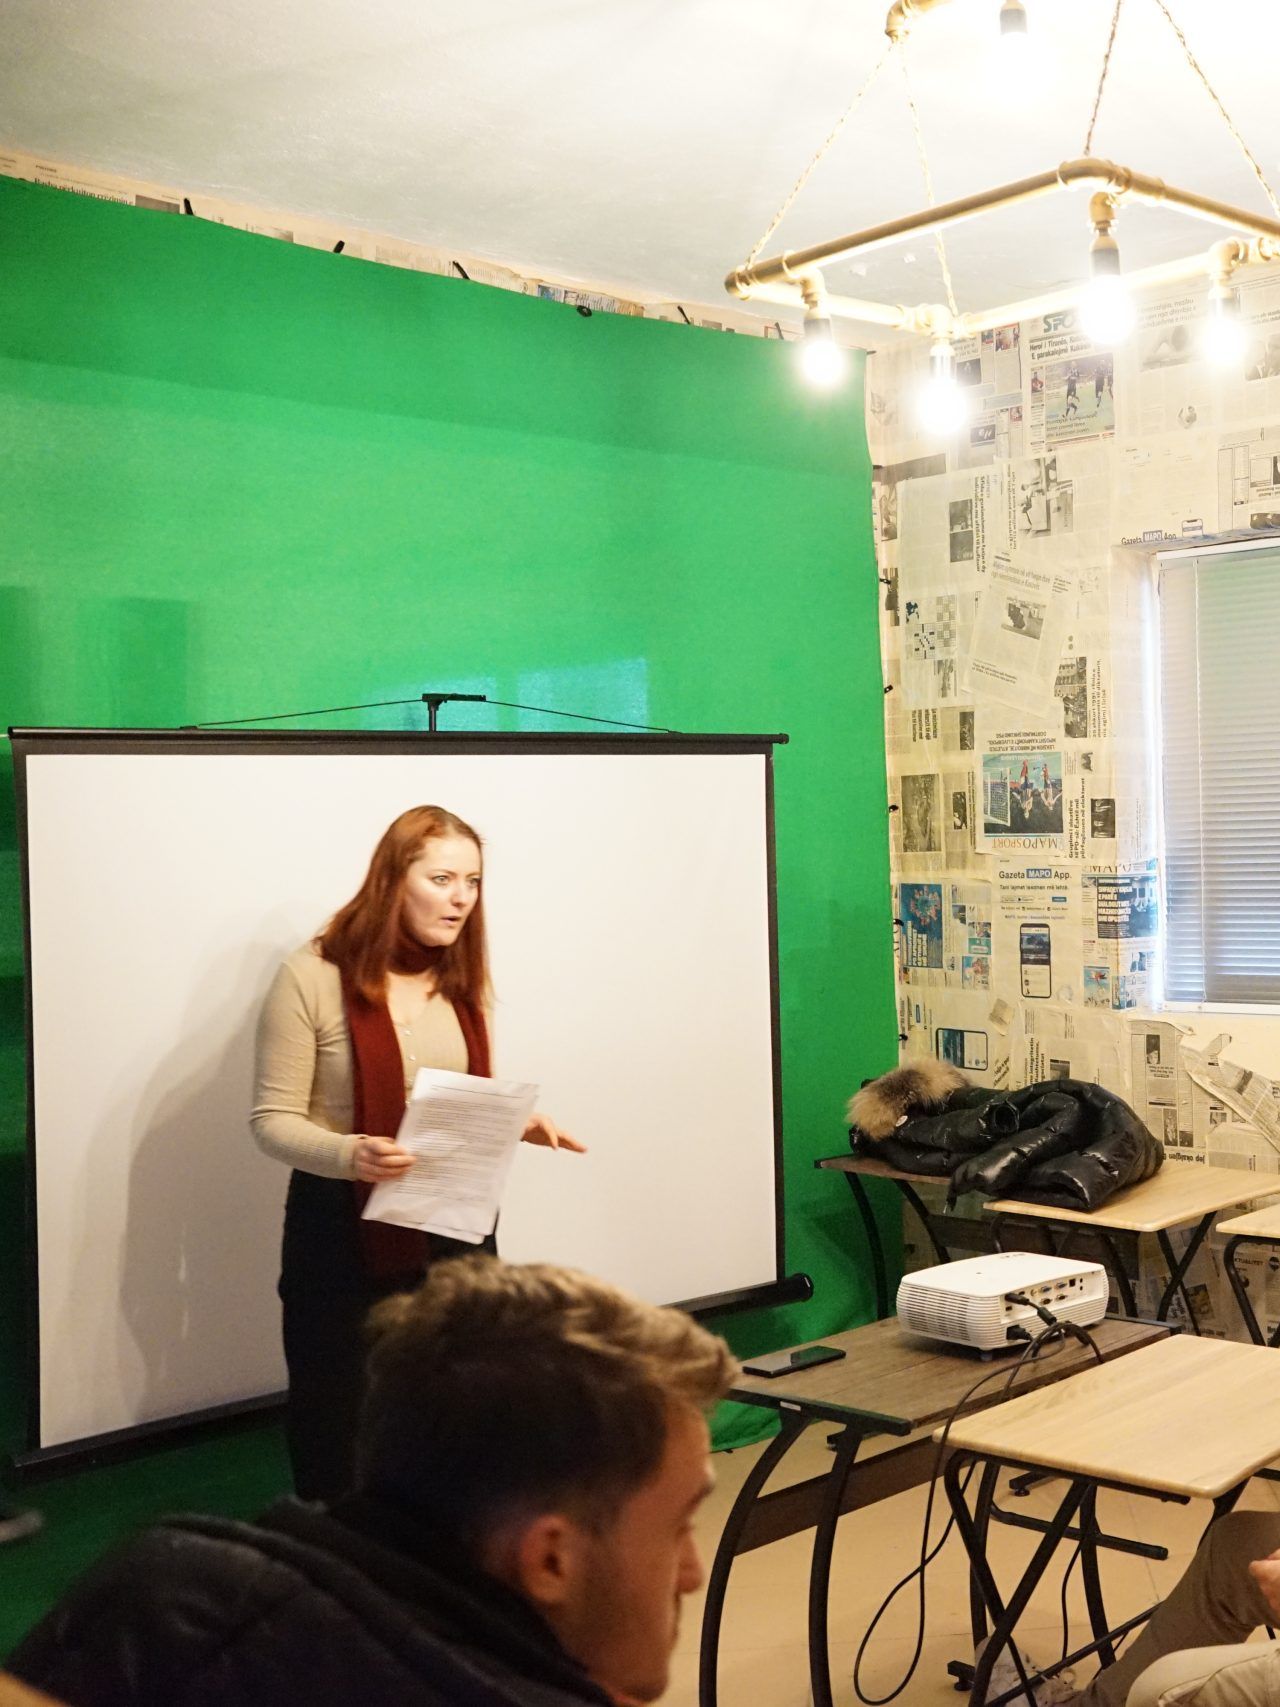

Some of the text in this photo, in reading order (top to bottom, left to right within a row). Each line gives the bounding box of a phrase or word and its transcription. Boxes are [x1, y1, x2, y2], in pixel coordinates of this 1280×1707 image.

[999, 870, 1072, 880] Gazeta MAPO App.
